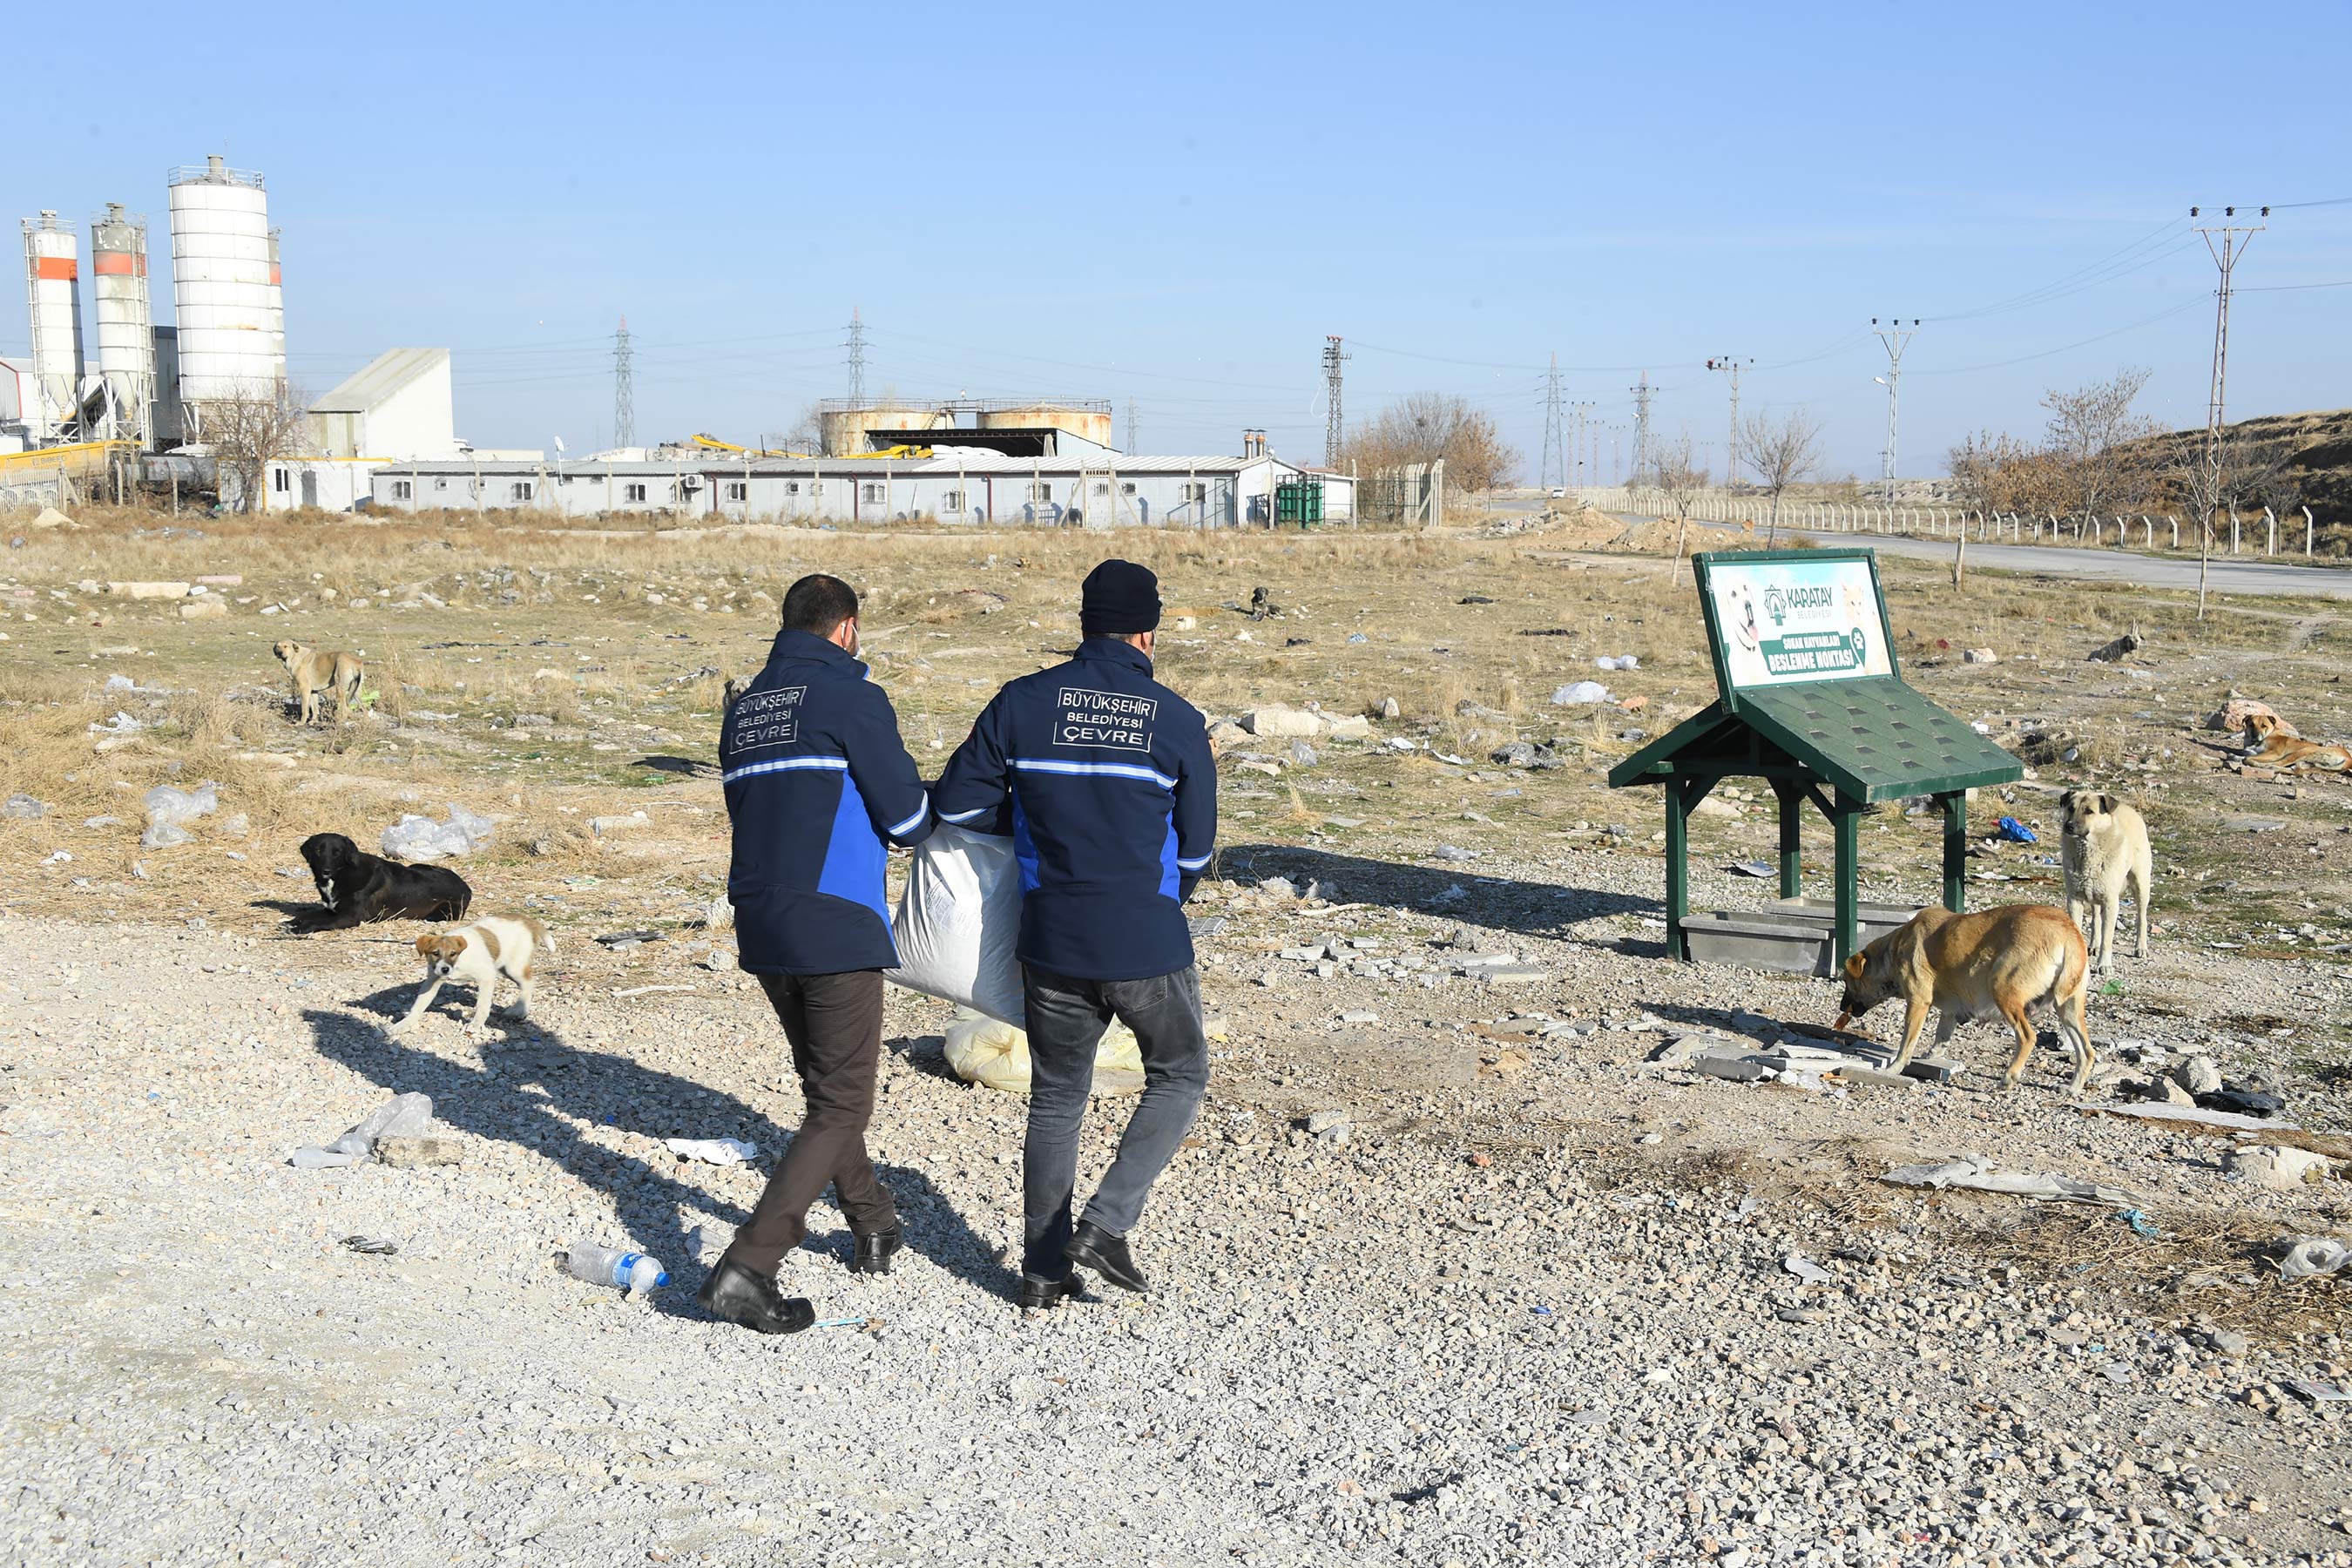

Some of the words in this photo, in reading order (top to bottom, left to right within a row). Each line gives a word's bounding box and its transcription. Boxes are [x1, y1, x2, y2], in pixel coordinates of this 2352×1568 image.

[1786, 587, 1833, 608] KARATAY
[1782, 637, 1804, 650] SOKAK
[1803, 635, 1841, 648] HAYVANLARI
[1767, 652, 1816, 672] BESLENME
[1815, 649, 1855, 668] NOKTASI
[735, 690, 800, 714] BÜYÜKŞEHİR
[1063, 692, 1151, 717] BÜYÜKŞEHİR
[738, 708, 792, 728] BELEDİYESİ
[1066, 712, 1143, 729] BELEDİYESİ
[735, 724, 792, 748] ÇEVRE
[1063, 726, 1144, 745] ÇEVRE
